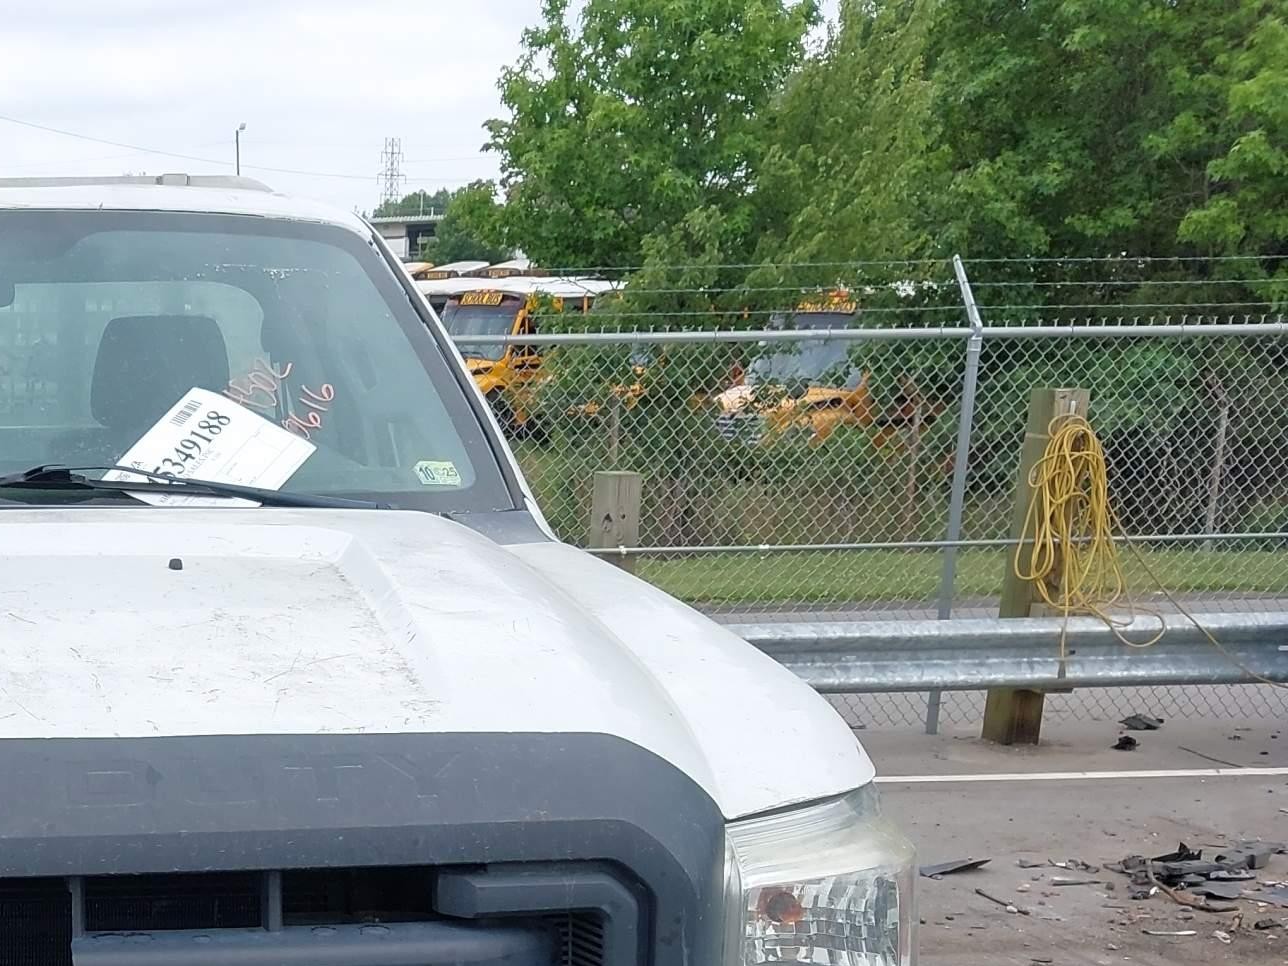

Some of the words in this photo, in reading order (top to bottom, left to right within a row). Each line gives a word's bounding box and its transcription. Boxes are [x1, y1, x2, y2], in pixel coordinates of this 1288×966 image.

[418, 466, 436, 481] 10
[442, 466, 458, 477] 25
[64, 751, 464, 808] DUTY
